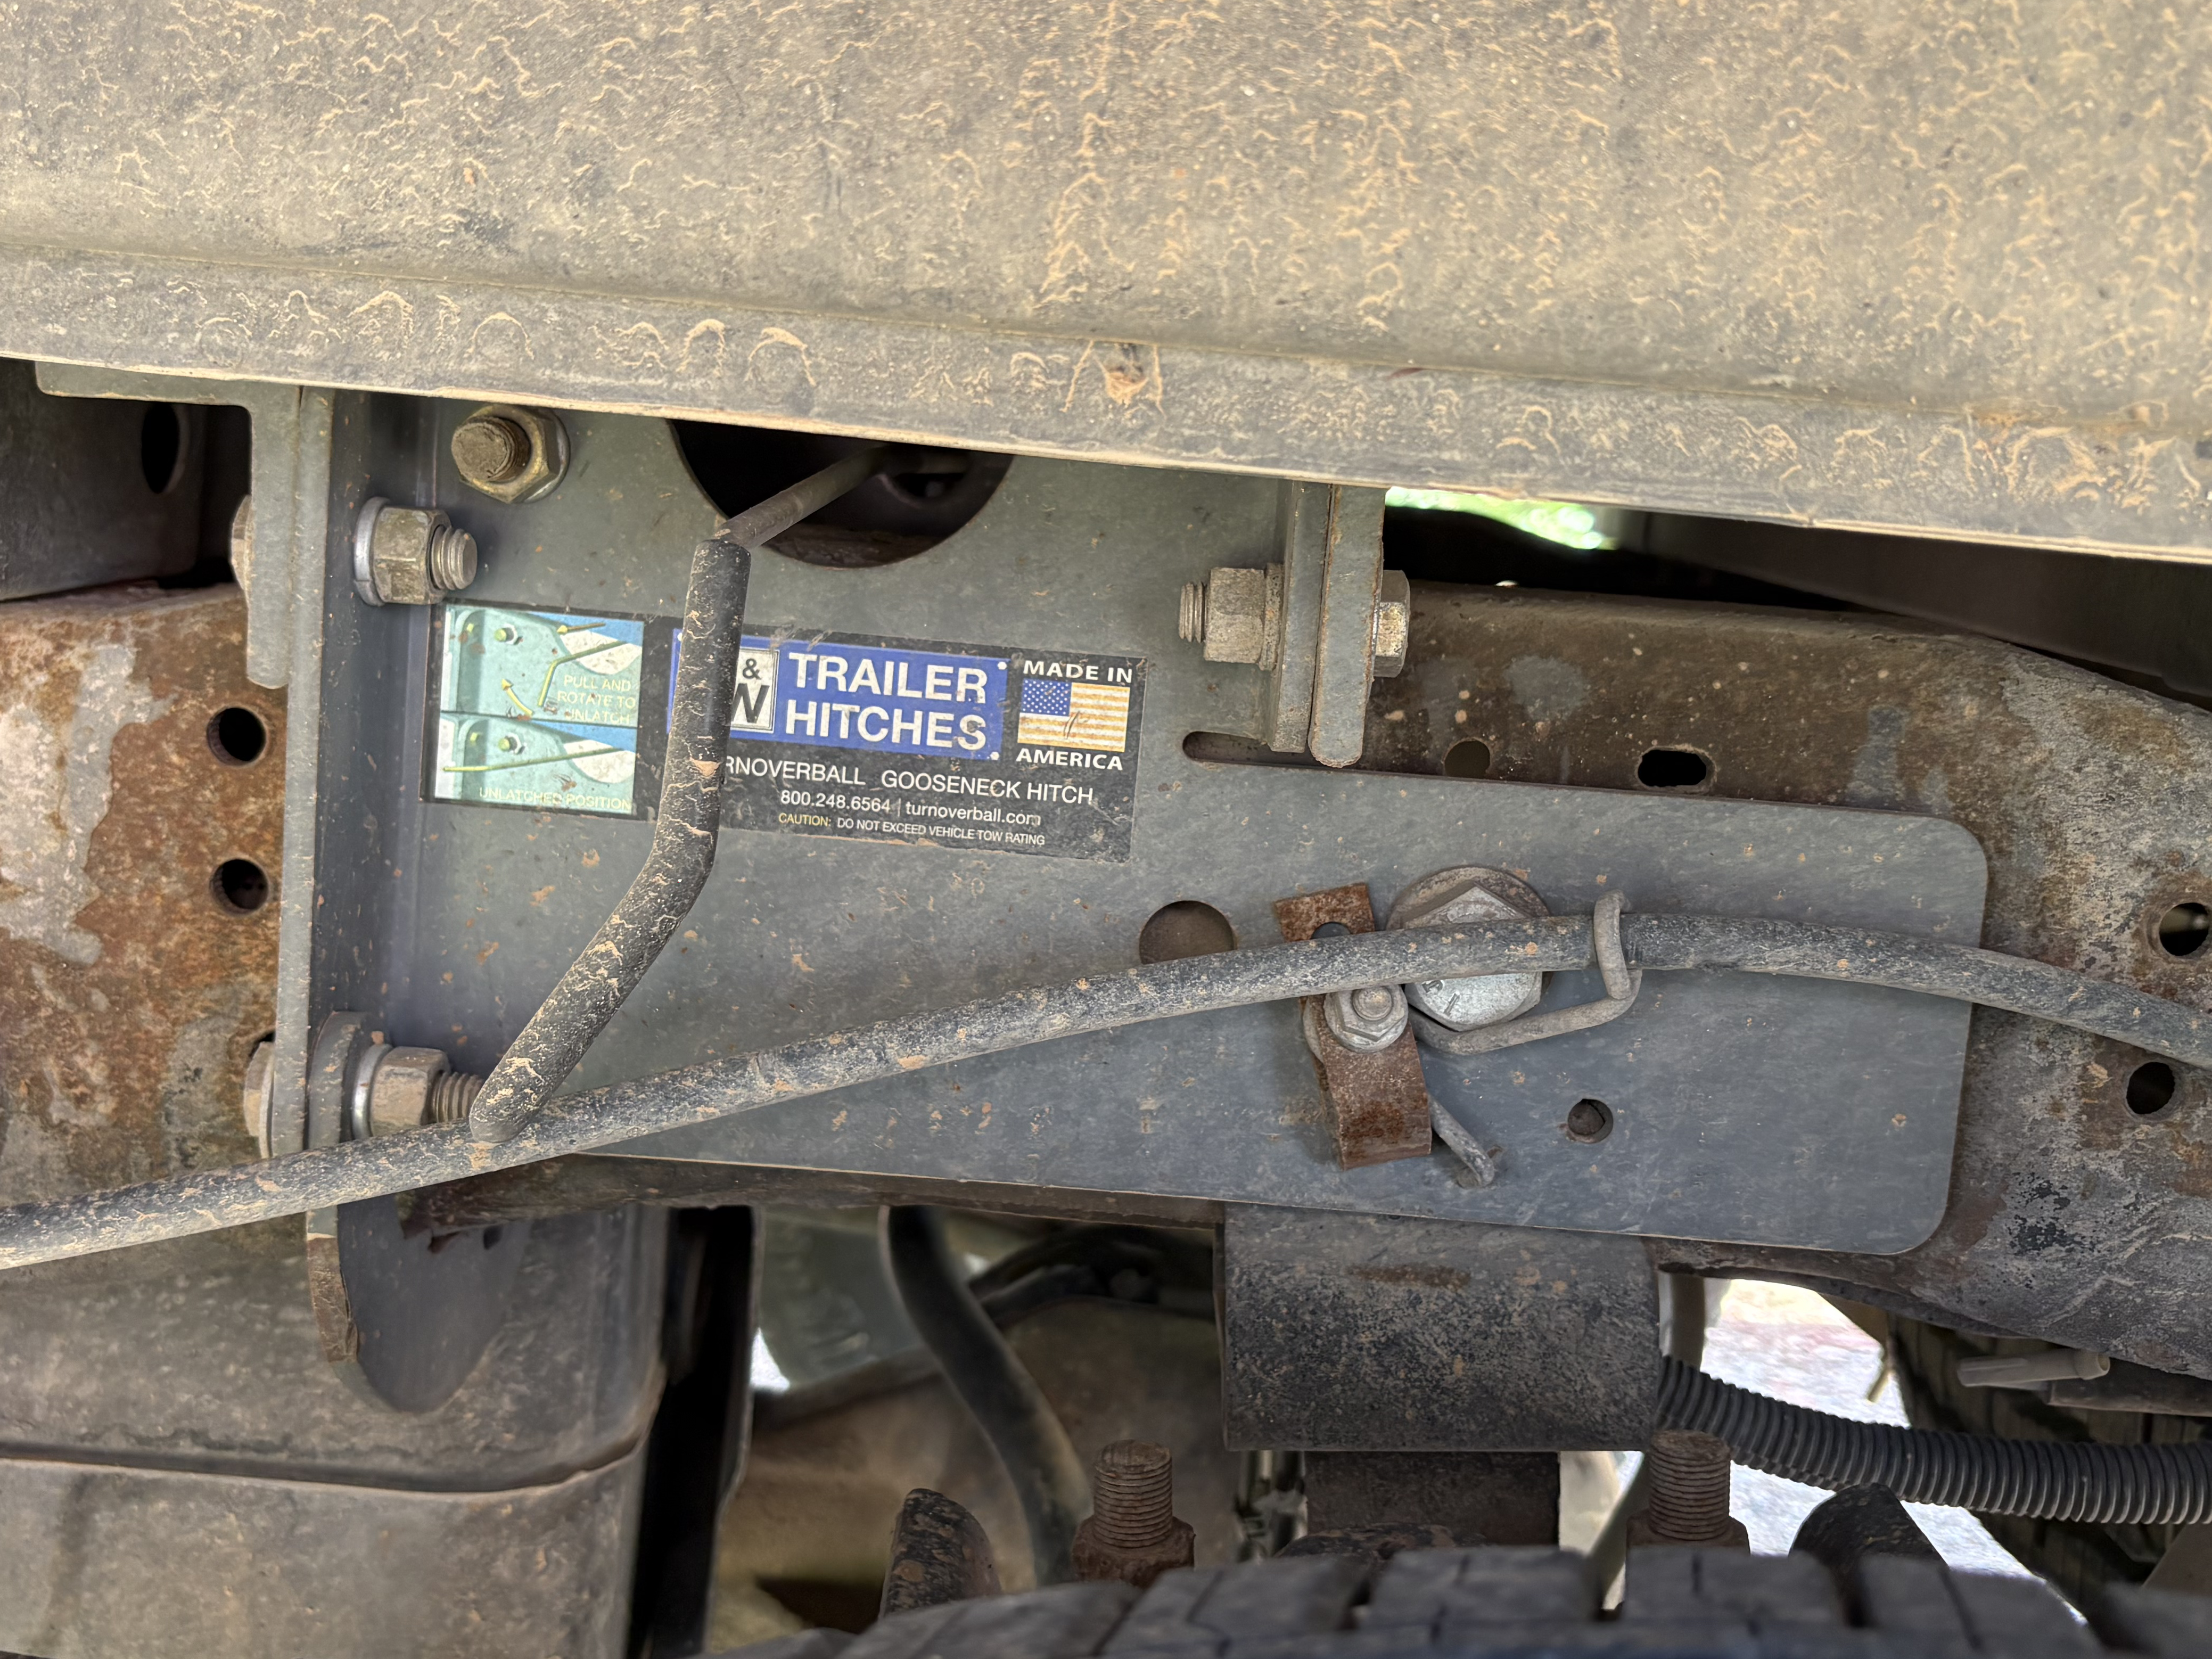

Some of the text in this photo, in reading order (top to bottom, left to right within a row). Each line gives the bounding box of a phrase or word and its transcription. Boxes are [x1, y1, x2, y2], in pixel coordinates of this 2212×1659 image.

[564, 675, 631, 692] PULL AND
[788, 652, 988, 704] TRAILER
[1023, 660, 1132, 683] MADE IN
[557, 691, 636, 709] ROTATE TO
[565, 709, 630, 724] UNLATCH
[786, 699, 986, 750] HITCHES
[1016, 748, 1123, 770] AMERICA
[726, 756, 1093, 804] RNOVERBALL GOOSENECK HITCH
[479, 787, 631, 811] UNLATCHED POSITION
[780, 790, 891, 812] 800.248.6564
[906, 801, 1041, 825] turnoverball.com
[779, 812, 1045, 845] CAUTION: DO NOT EXCEED VEHICLE TOW RATING
